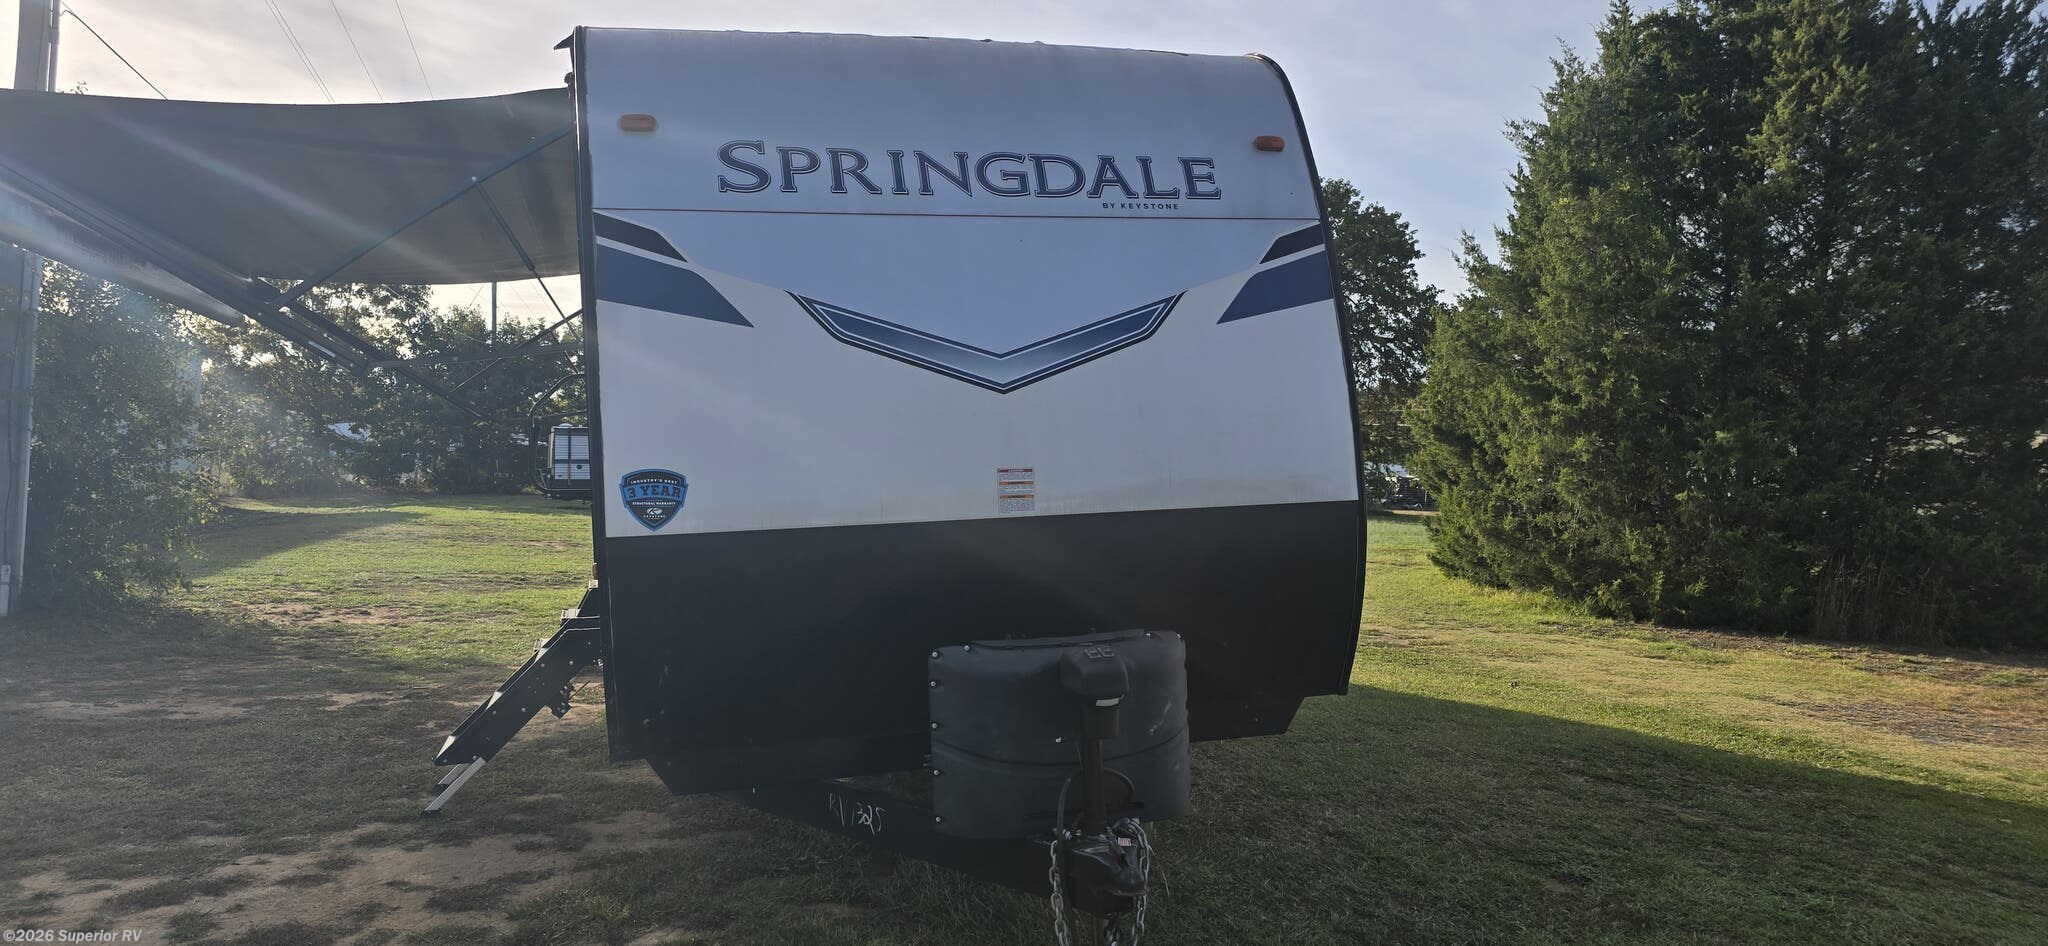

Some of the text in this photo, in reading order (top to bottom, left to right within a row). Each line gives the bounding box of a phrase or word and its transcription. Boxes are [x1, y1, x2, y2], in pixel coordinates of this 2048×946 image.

[717, 139, 1223, 200] SPRINGDALE
[1120, 202, 1179, 210] KEYSTONE
[627, 485, 681, 498] 3 YEAR
